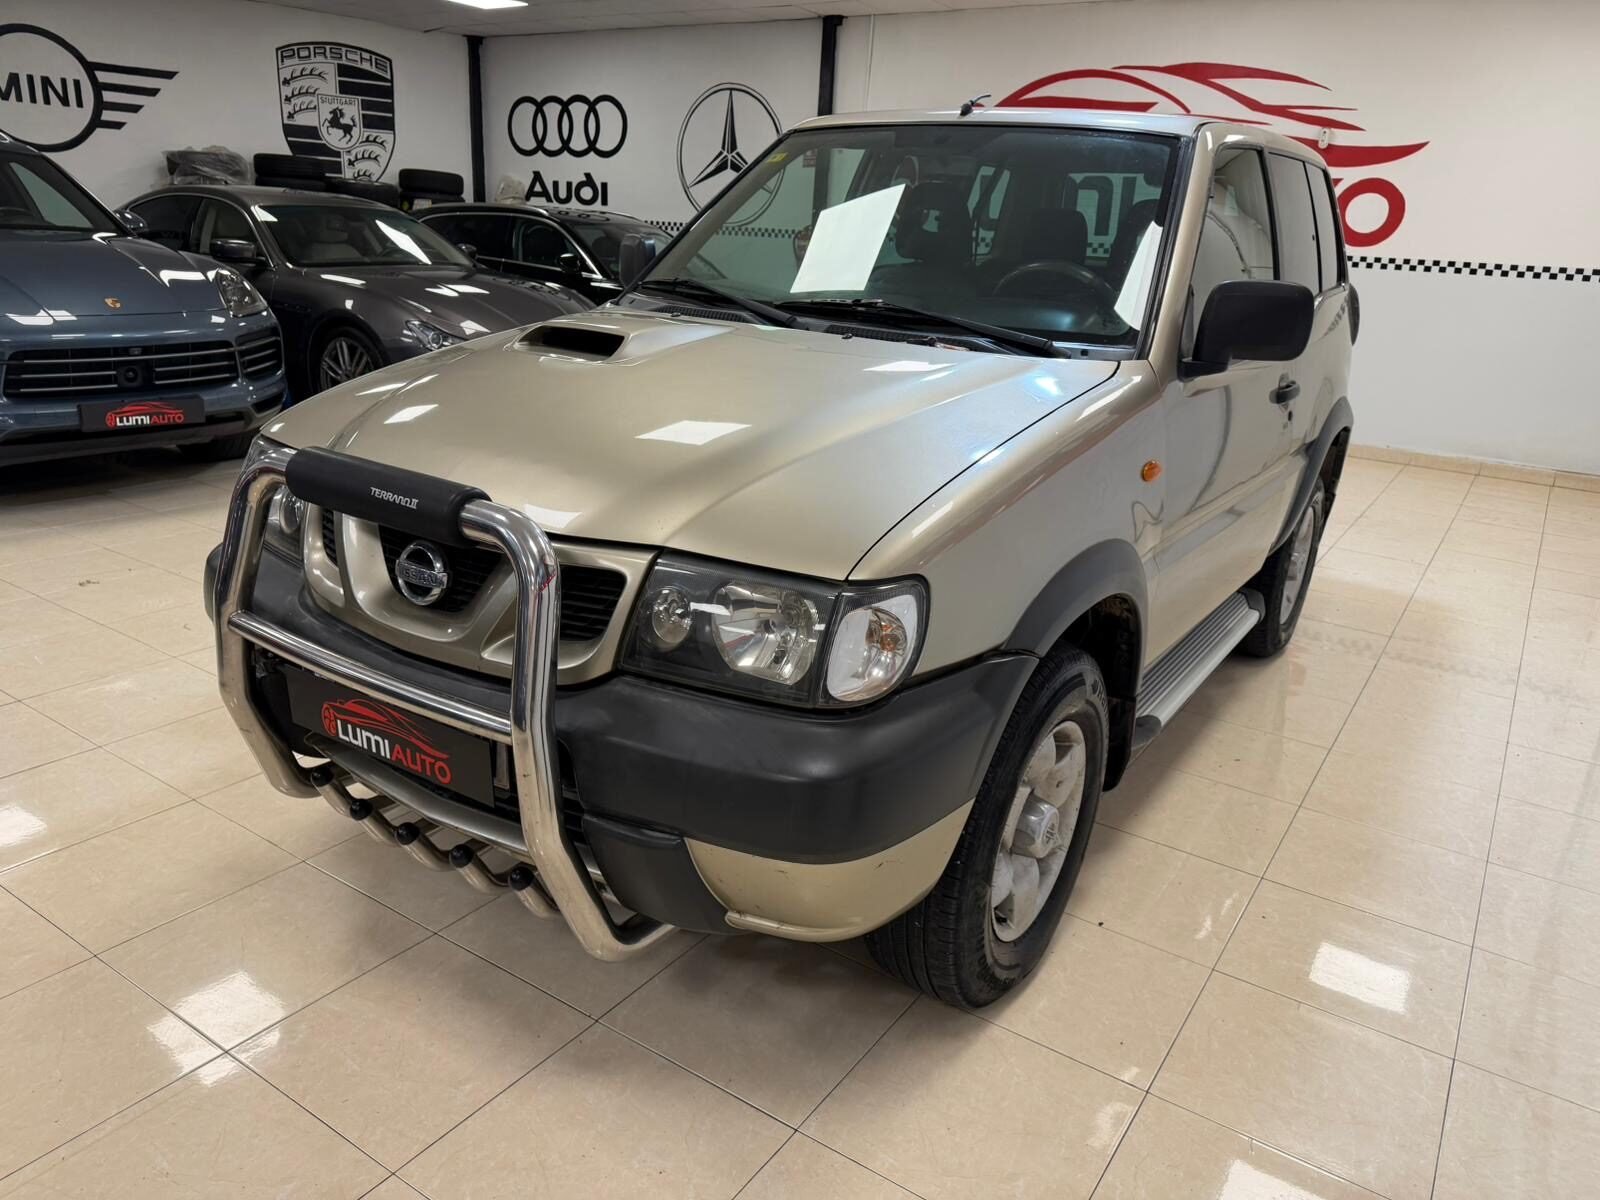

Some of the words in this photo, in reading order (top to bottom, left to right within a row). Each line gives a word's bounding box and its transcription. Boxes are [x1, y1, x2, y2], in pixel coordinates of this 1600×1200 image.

[280, 46, 389, 76] PORSCHE
[0, 72, 84, 108] MINI
[525, 171, 608, 206] Audi
